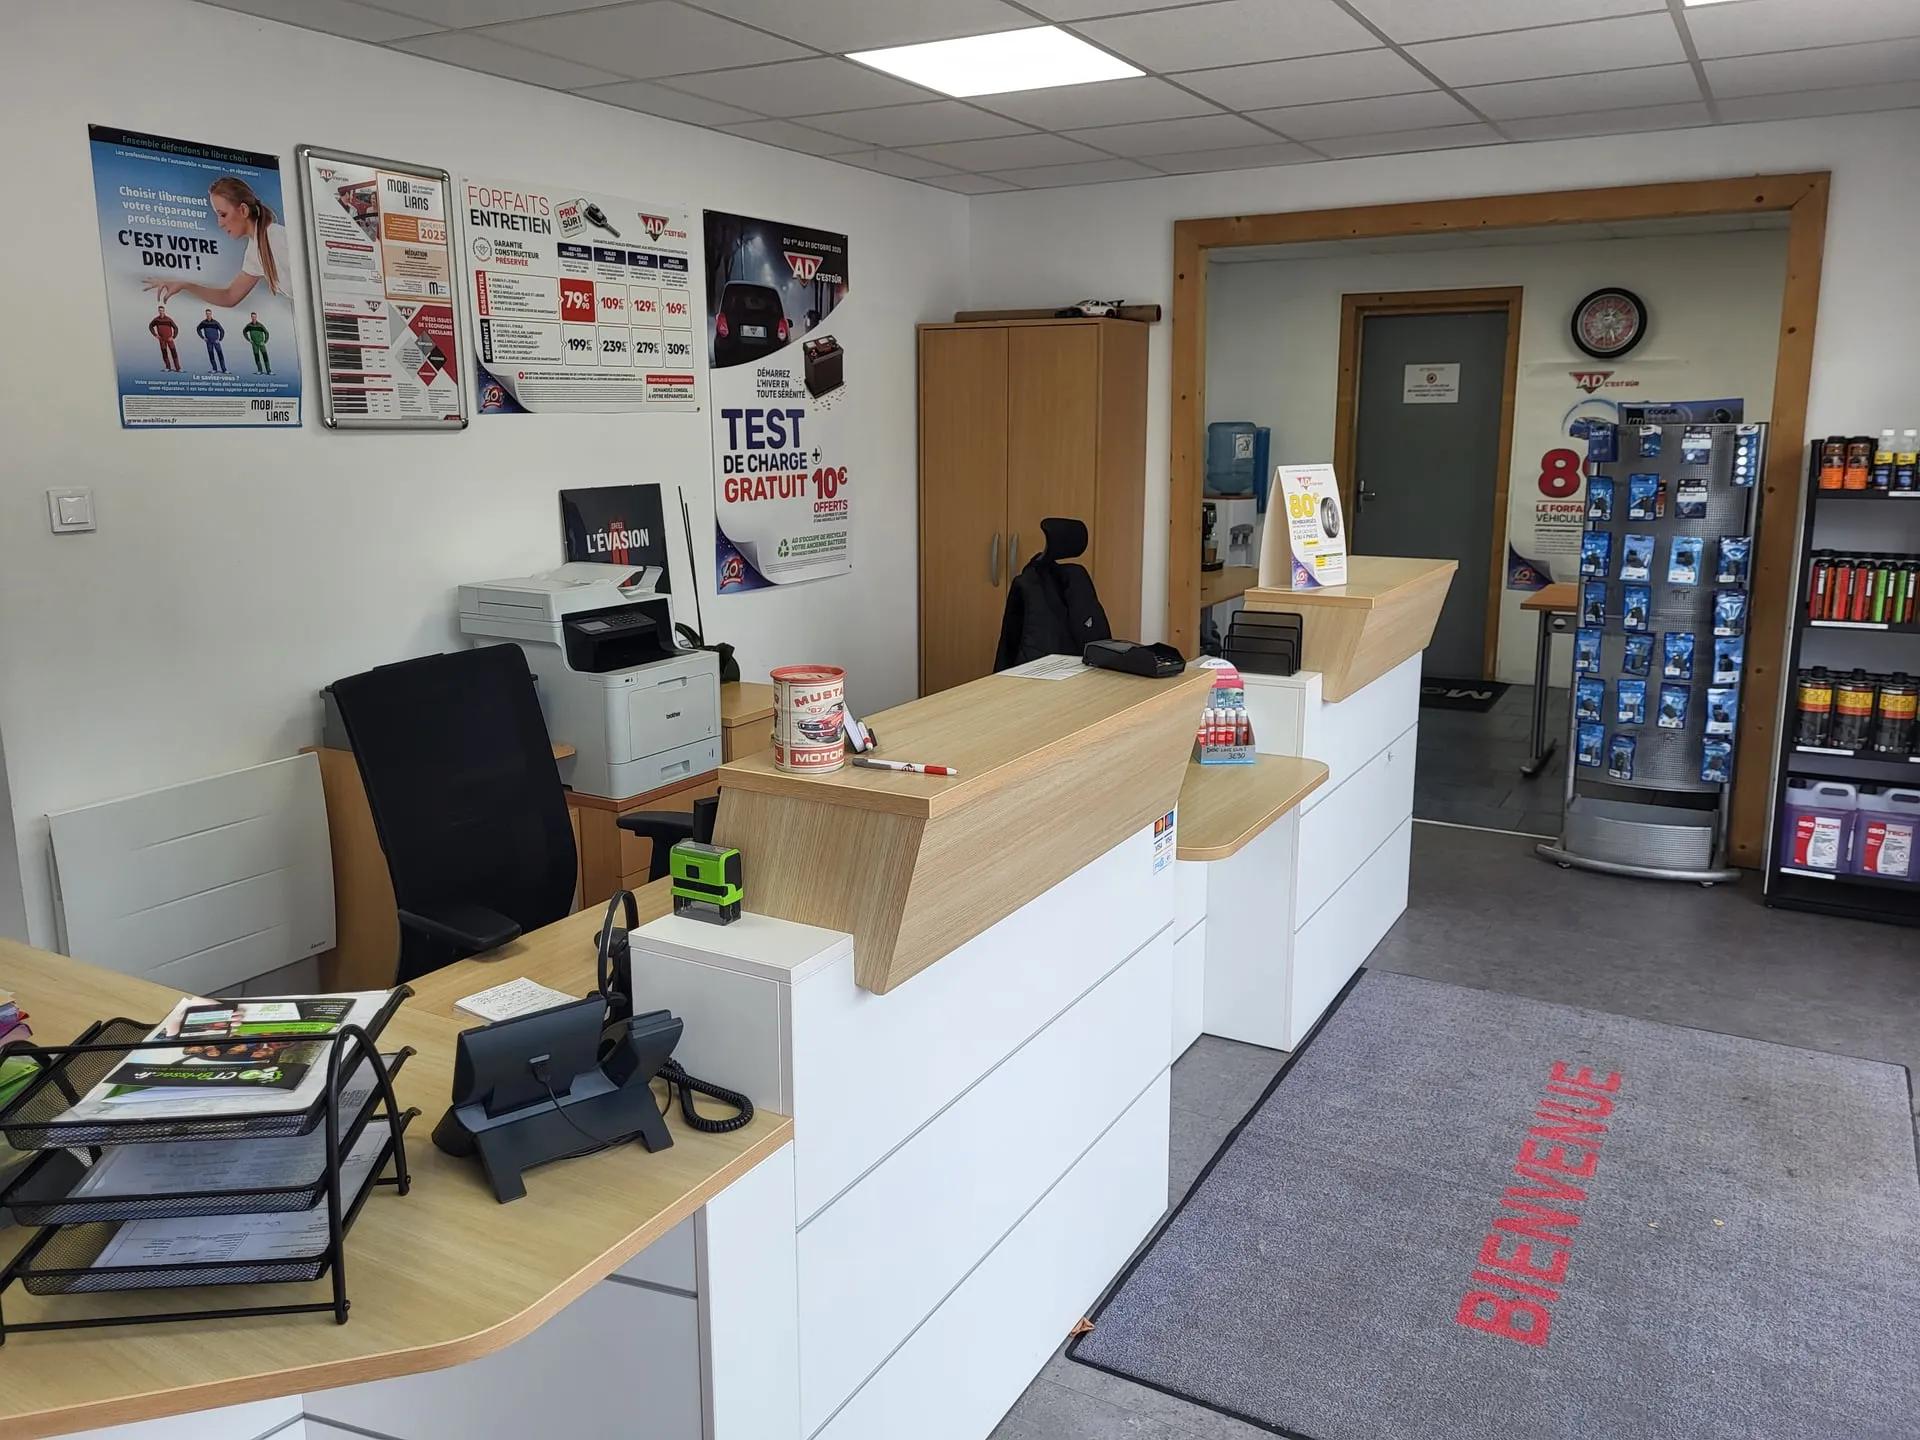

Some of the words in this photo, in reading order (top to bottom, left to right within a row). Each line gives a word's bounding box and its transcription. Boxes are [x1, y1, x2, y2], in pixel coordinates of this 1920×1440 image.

[122, 135, 160, 149] Ensemble
[160, 141, 200, 156] défendons
[202, 148, 209, 157] le
[211, 149, 228, 160] libre
[229, 152, 248, 164] choix
[387, 179, 411, 193] MOBI
[120, 186, 156, 200] Choisir
[159, 190, 208, 206] librement
[468, 186, 550, 216] FORFAITS
[404, 196, 429, 210] LIANS
[122, 201, 150, 212] votre
[154, 203, 208, 219] réparateur
[558, 206, 578, 218] PRIX
[470, 208, 552, 235] ENTRETIEN
[648, 220, 662, 232] AD
[421, 228, 446, 241] 2025
[118, 230, 163, 248] C'EST
[167, 235, 218, 254] VOTRE
[494, 240, 522, 249] GARANTIE
[810, 242, 831, 252] OCTOBRE
[494, 248, 540, 259] CONSTRUCTEUR
[142, 251, 192, 270] DROIT
[196, 256, 201, 271] !
[496, 256, 528, 266] PRÉSERVÉE
[792, 258, 816, 280] AD
[816, 272, 832, 283] C'EST
[831, 274, 842, 284] SÛR
[478, 272, 488, 314] ESSENTIEL
[482, 322, 491, 360] SÉRÉNITÉ
[757, 367, 790, 378] DÉMARREZ
[757, 380, 780, 388] L'HIVER
[781, 380, 789, 388] EN
[1579, 376, 1604, 388] AD
[757, 390, 778, 398] TOUTE
[778, 389, 806, 399] SÉRÉNITÉ
[251, 400, 273, 410] MOBI
[266, 411, 290, 422] LIANS
[721, 408, 805, 450] TEST
[724, 454, 744, 474] DE
[748, 452, 808, 472] CHARGE
[724, 474, 808, 503] GRATUIT
[812, 466, 848, 500] 10€
[814, 500, 848, 513] OFFERTS
[1536, 504, 1549, 513] LE
[586, 528, 650, 554] L'ÉVASION
[792, 542, 806, 551] VOTRE
[806, 540, 828, 550] ANCIENNE
[828, 538, 847, 546] BATTERIE
[799, 535, 820, 543] S'OCCUPE
[1455, 1060, 1624, 1348] BIENVENUE
